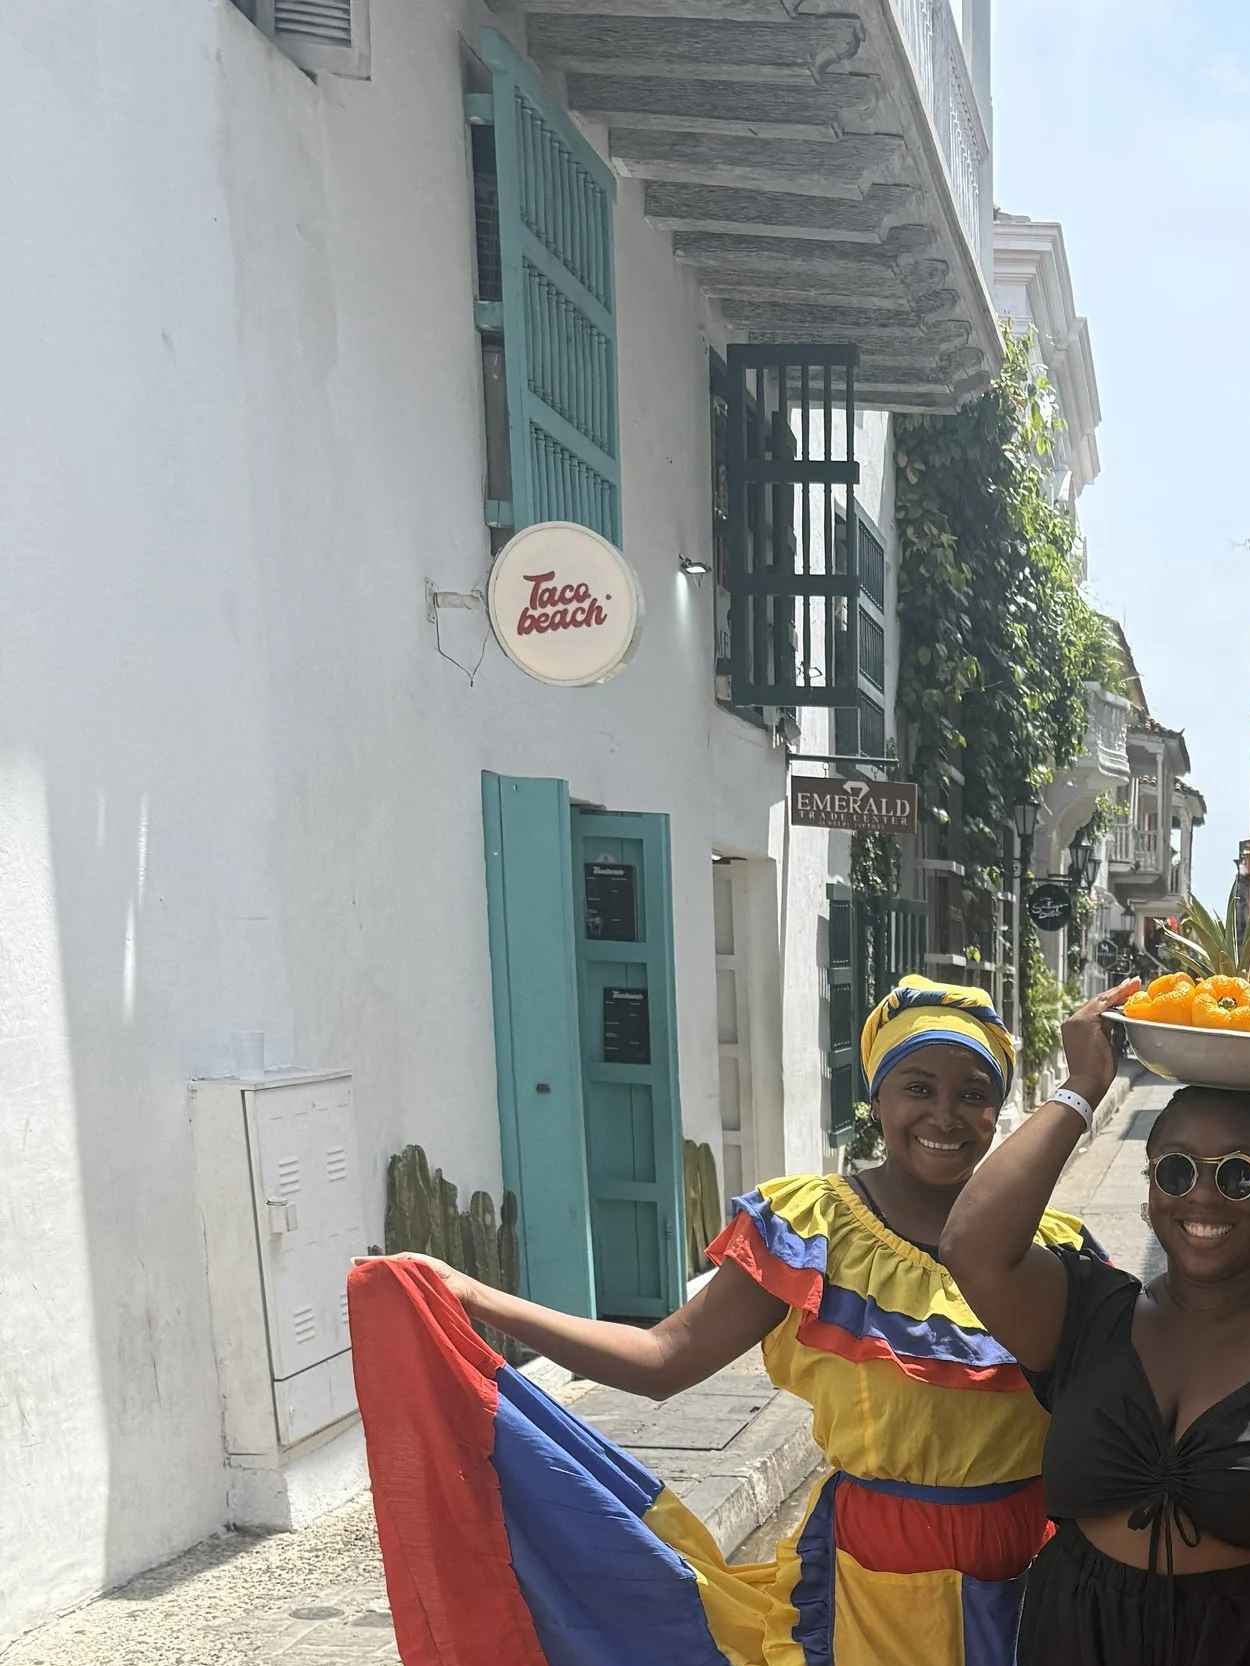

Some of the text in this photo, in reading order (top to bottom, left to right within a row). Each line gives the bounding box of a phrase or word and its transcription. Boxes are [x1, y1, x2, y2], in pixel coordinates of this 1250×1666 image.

[523, 571, 591, 610] Taco
[517, 598, 607, 635] beach
[797, 793, 911, 817] EMERALD
[799, 810, 908, 825] TRADE CENTER
